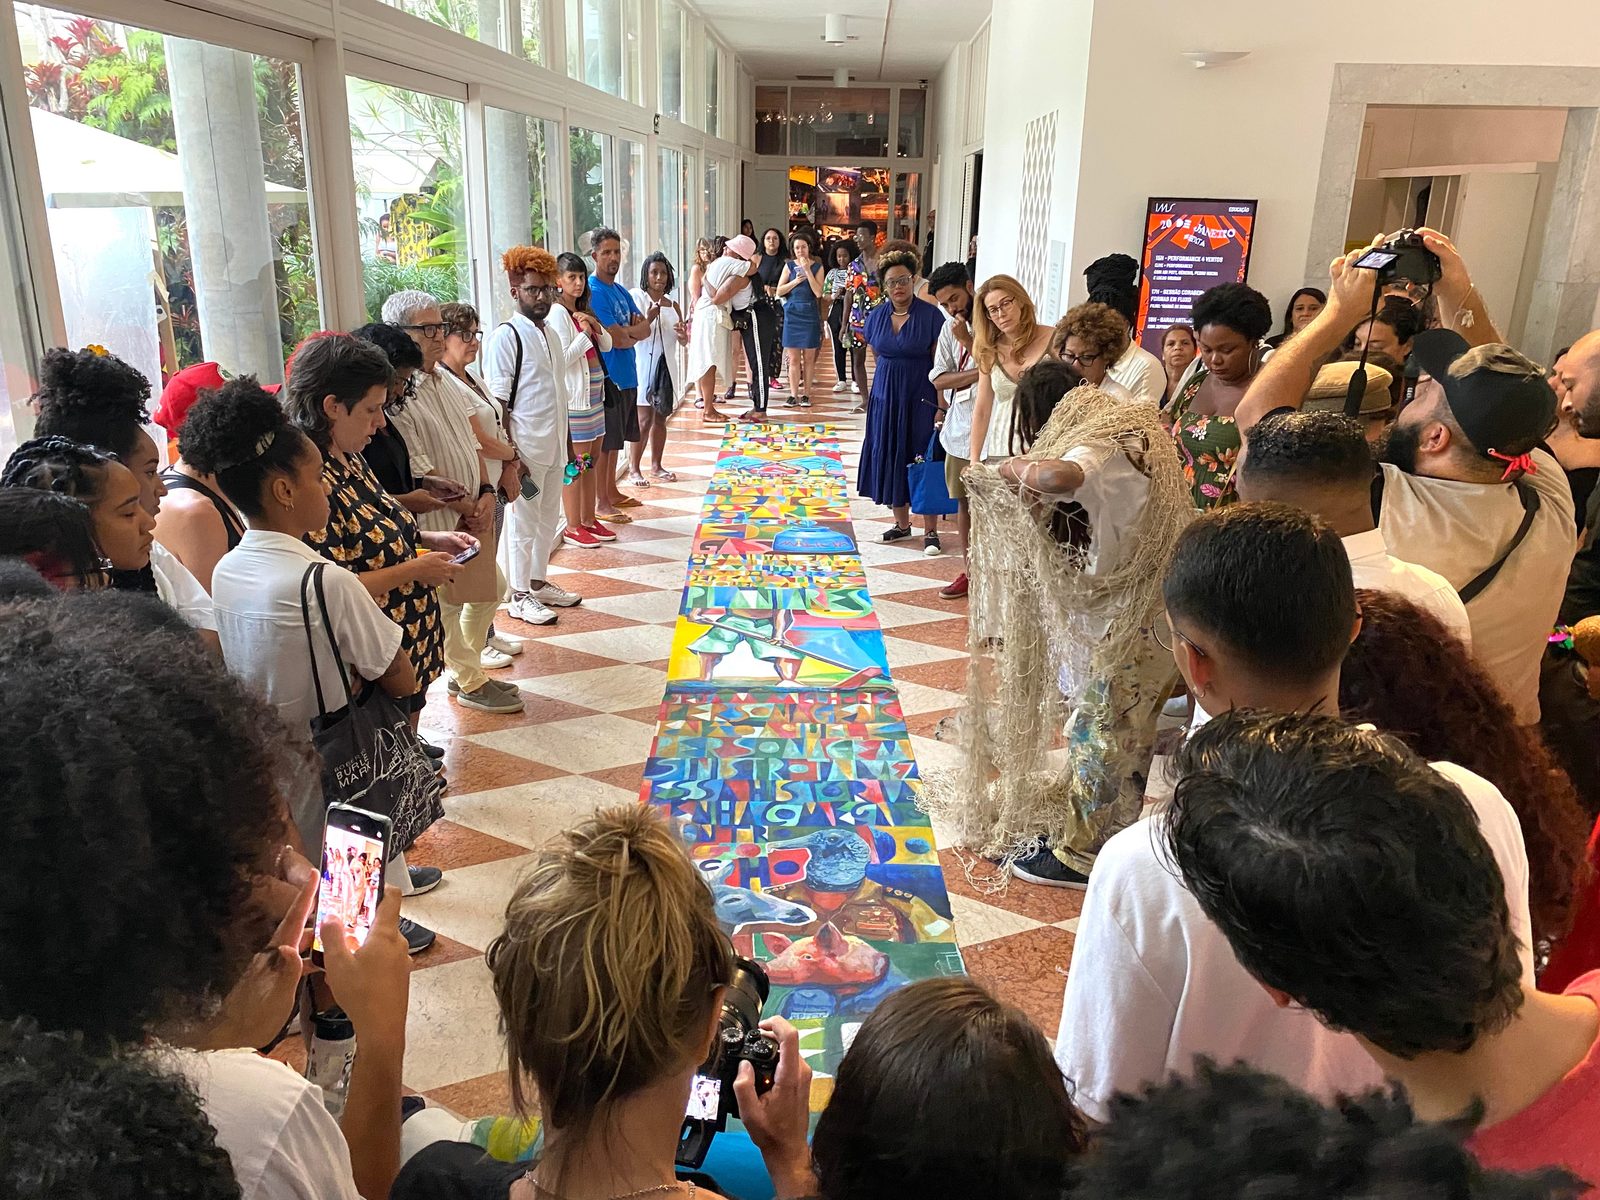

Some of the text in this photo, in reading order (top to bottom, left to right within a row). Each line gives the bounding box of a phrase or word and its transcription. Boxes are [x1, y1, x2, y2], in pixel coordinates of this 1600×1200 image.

[1176, 218, 1192, 229] DE
[1193, 223, 1236, 239] JANEIRO
[666, 702, 904, 724] PERSONAGENS
[656, 736, 914, 761] PERSONAGEM
[336, 753, 369, 780] BURLE
[339, 761, 371, 789] MARX
